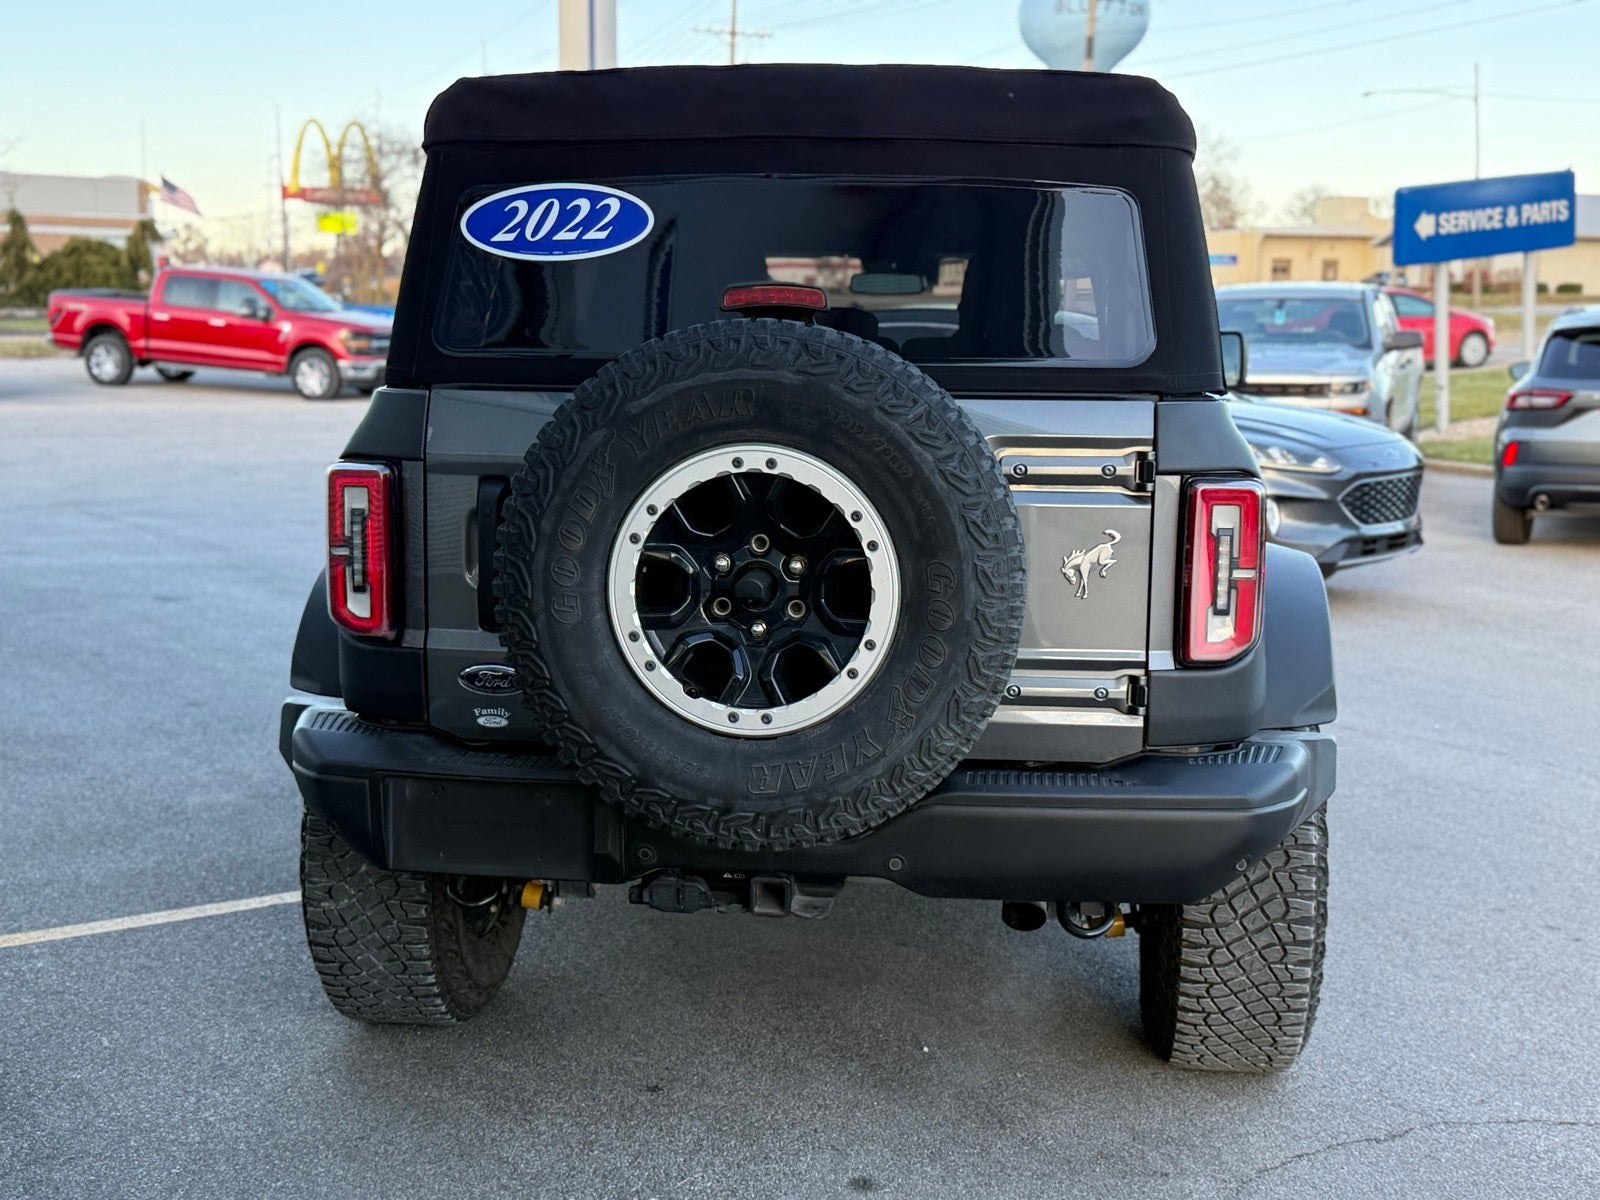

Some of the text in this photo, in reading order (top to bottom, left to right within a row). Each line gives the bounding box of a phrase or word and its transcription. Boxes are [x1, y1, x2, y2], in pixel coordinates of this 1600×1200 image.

[490, 197, 621, 242] 2022
[1437, 199, 1570, 236] SERVICE & PARTS
[474, 670, 512, 688] Ford
[473, 707, 512, 719] Family
